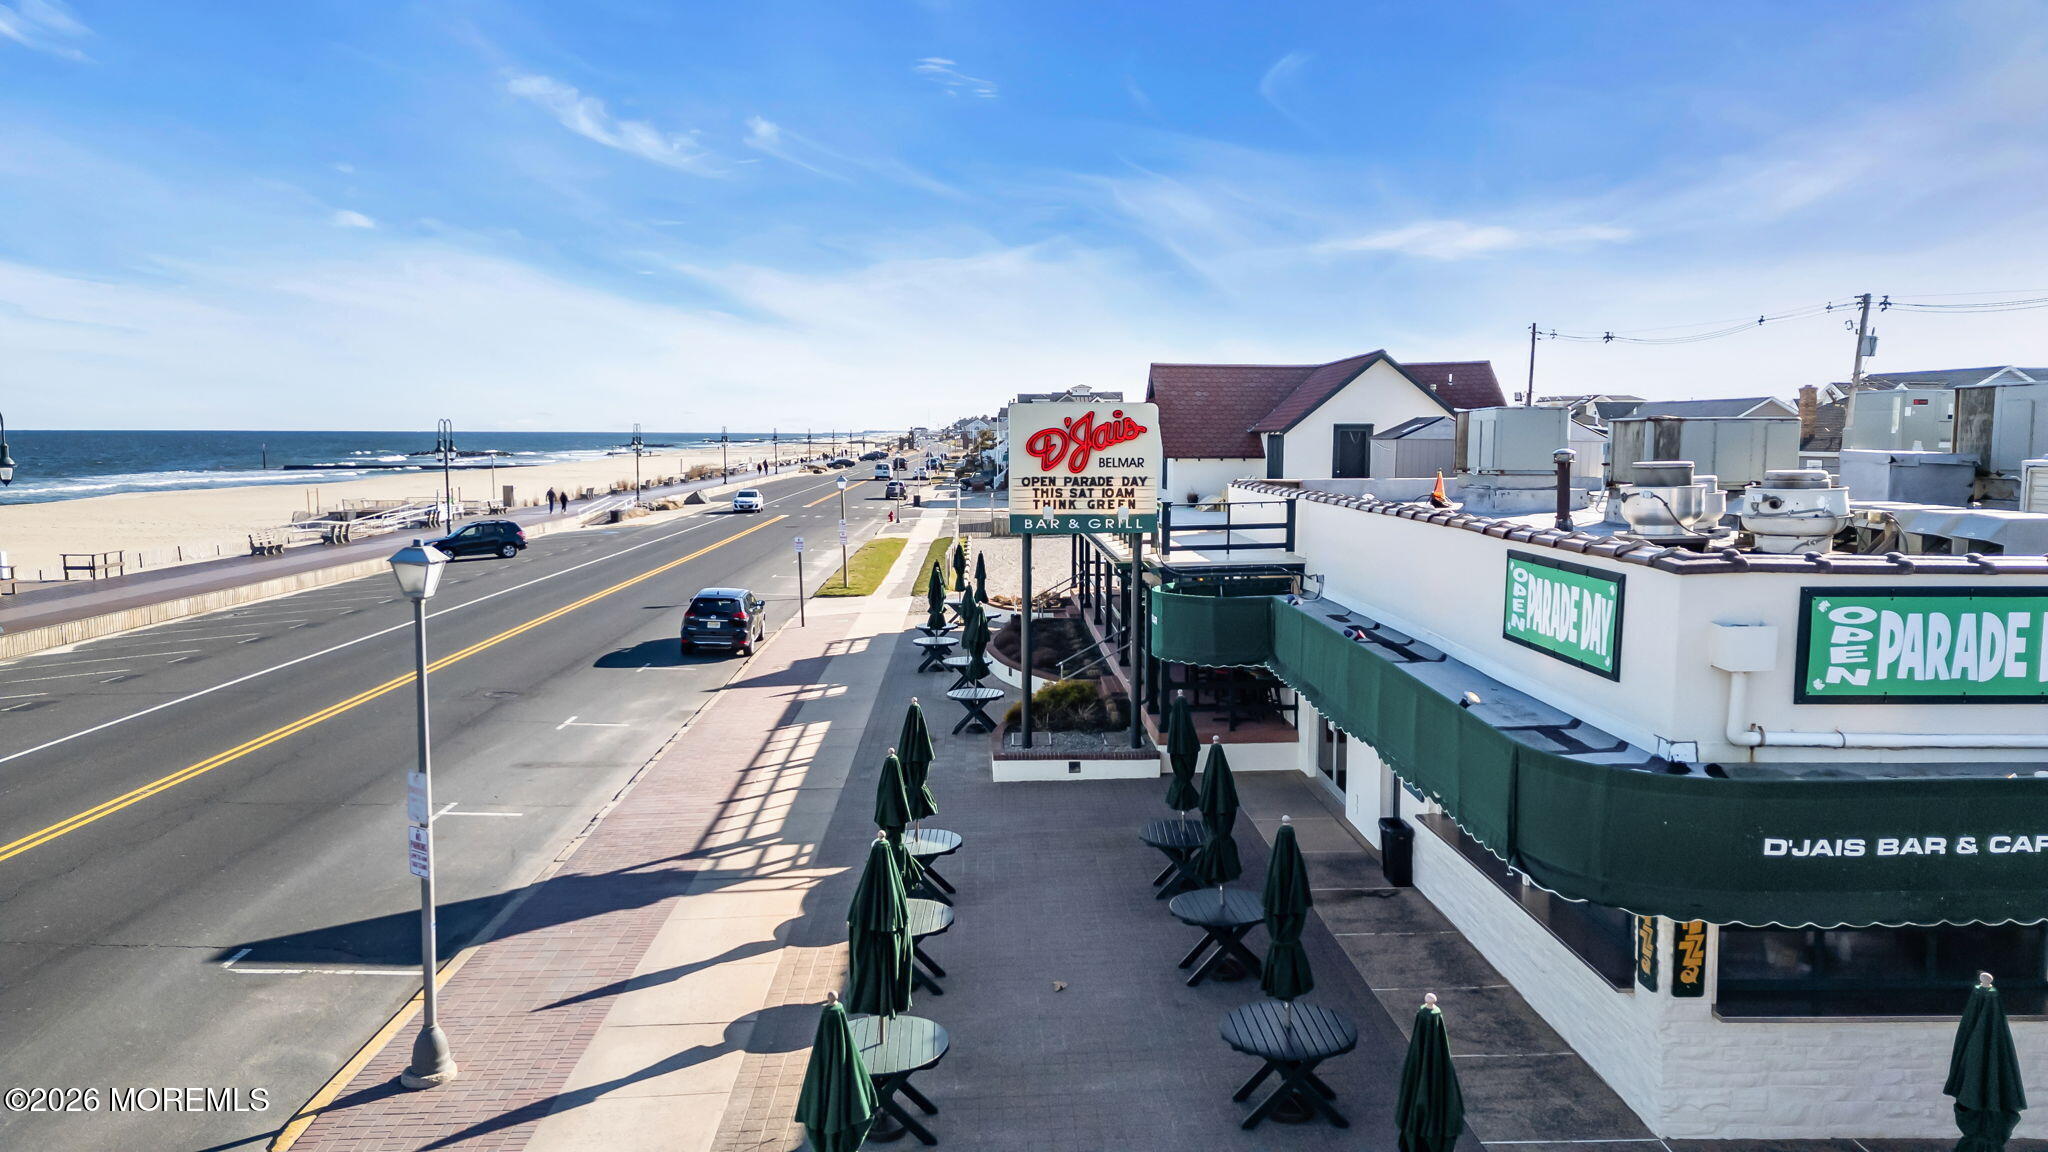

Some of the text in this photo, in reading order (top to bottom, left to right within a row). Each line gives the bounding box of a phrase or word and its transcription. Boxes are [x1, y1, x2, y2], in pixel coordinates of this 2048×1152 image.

[1026, 410, 1148, 473] D'Jais
[1099, 458, 1144, 468] BELMAR
[1022, 477, 1148, 487] OPEN PARADE DAY
[1033, 488, 1063, 498] THIS
[1069, 488, 1094, 498] SAT
[1033, 500, 1136, 510] THINK GREEN
[1025, 519, 1143, 529] BAR & GRILL
[1511, 568, 1528, 632] OPEN
[1526, 573, 1613, 656] PARADE DAY
[1825, 606, 1878, 686] OPEN
[1876, 610, 2031, 683] PARADE
[1764, 838, 1866, 857] D'JAIS
[1877, 837, 1948, 856] BAR
[1956, 837, 1979, 855] &
